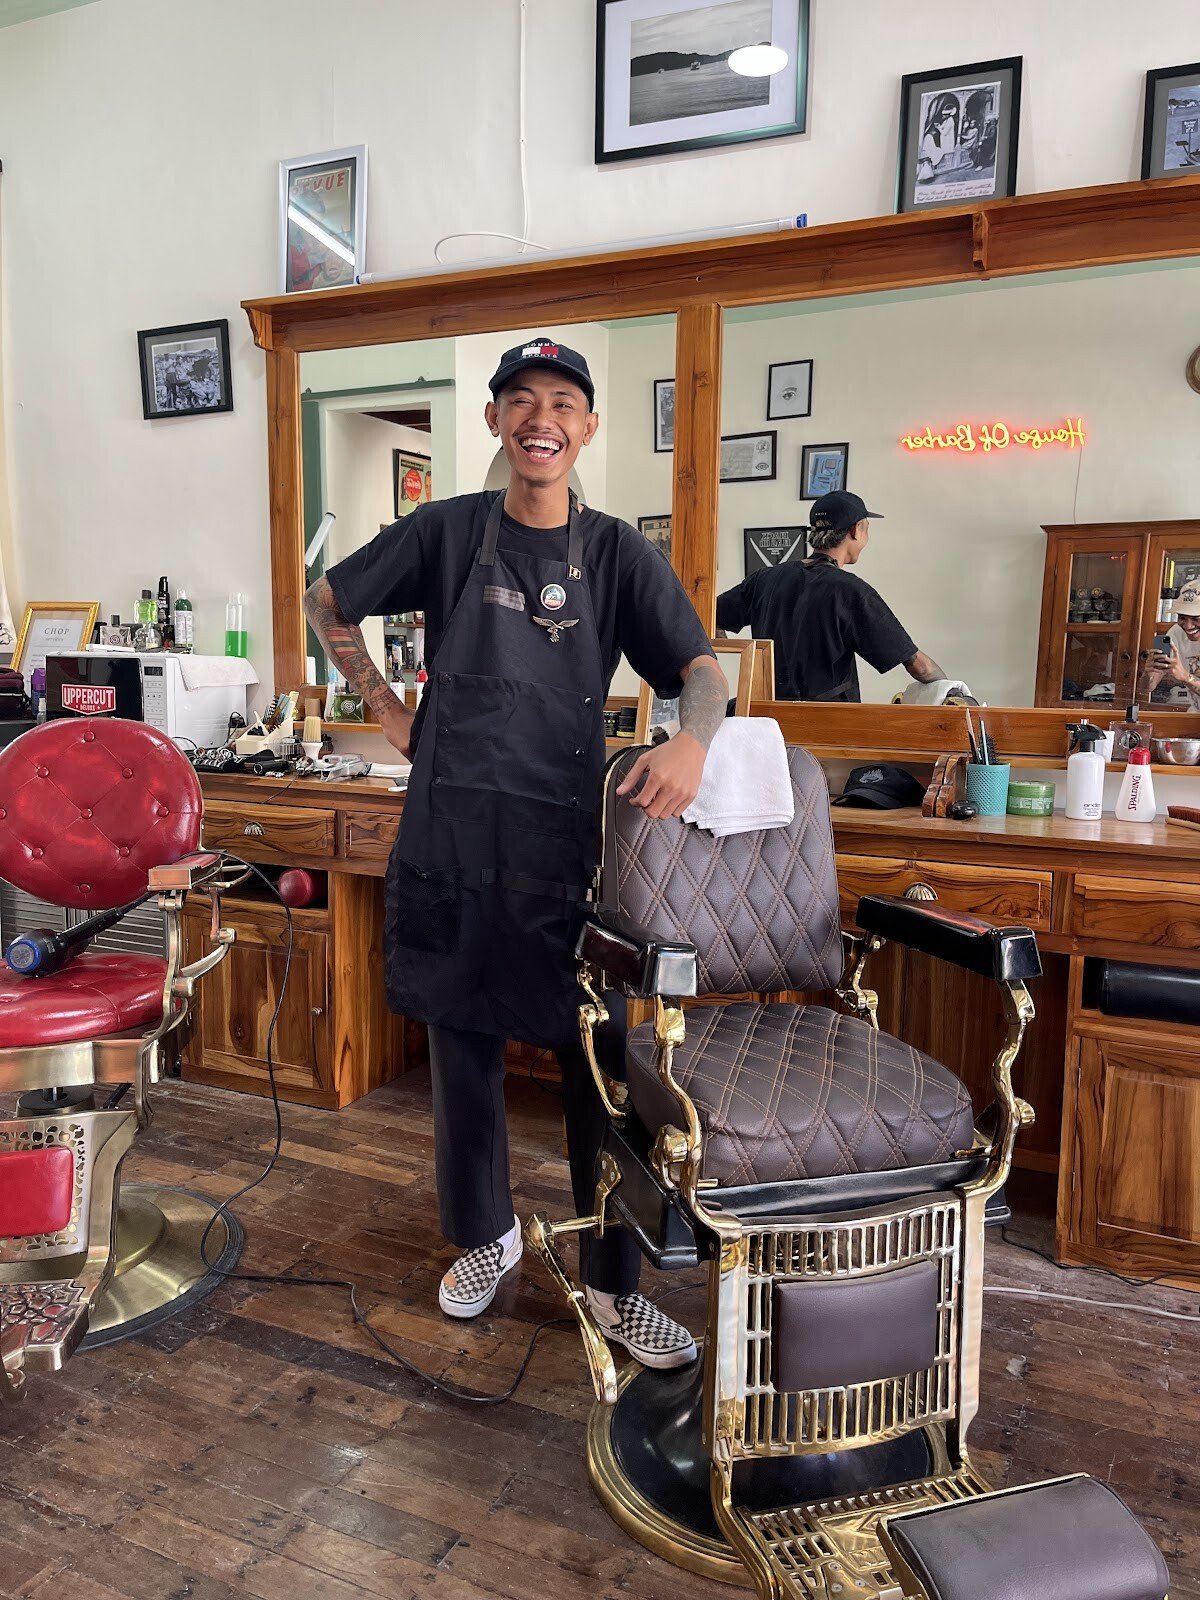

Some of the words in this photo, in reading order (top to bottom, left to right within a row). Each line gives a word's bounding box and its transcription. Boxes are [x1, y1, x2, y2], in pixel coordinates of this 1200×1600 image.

[44, 627, 70, 635] CHOP
[64, 687, 113, 708] UPPERCUT
[1128, 775, 1141, 811] SPALDING
